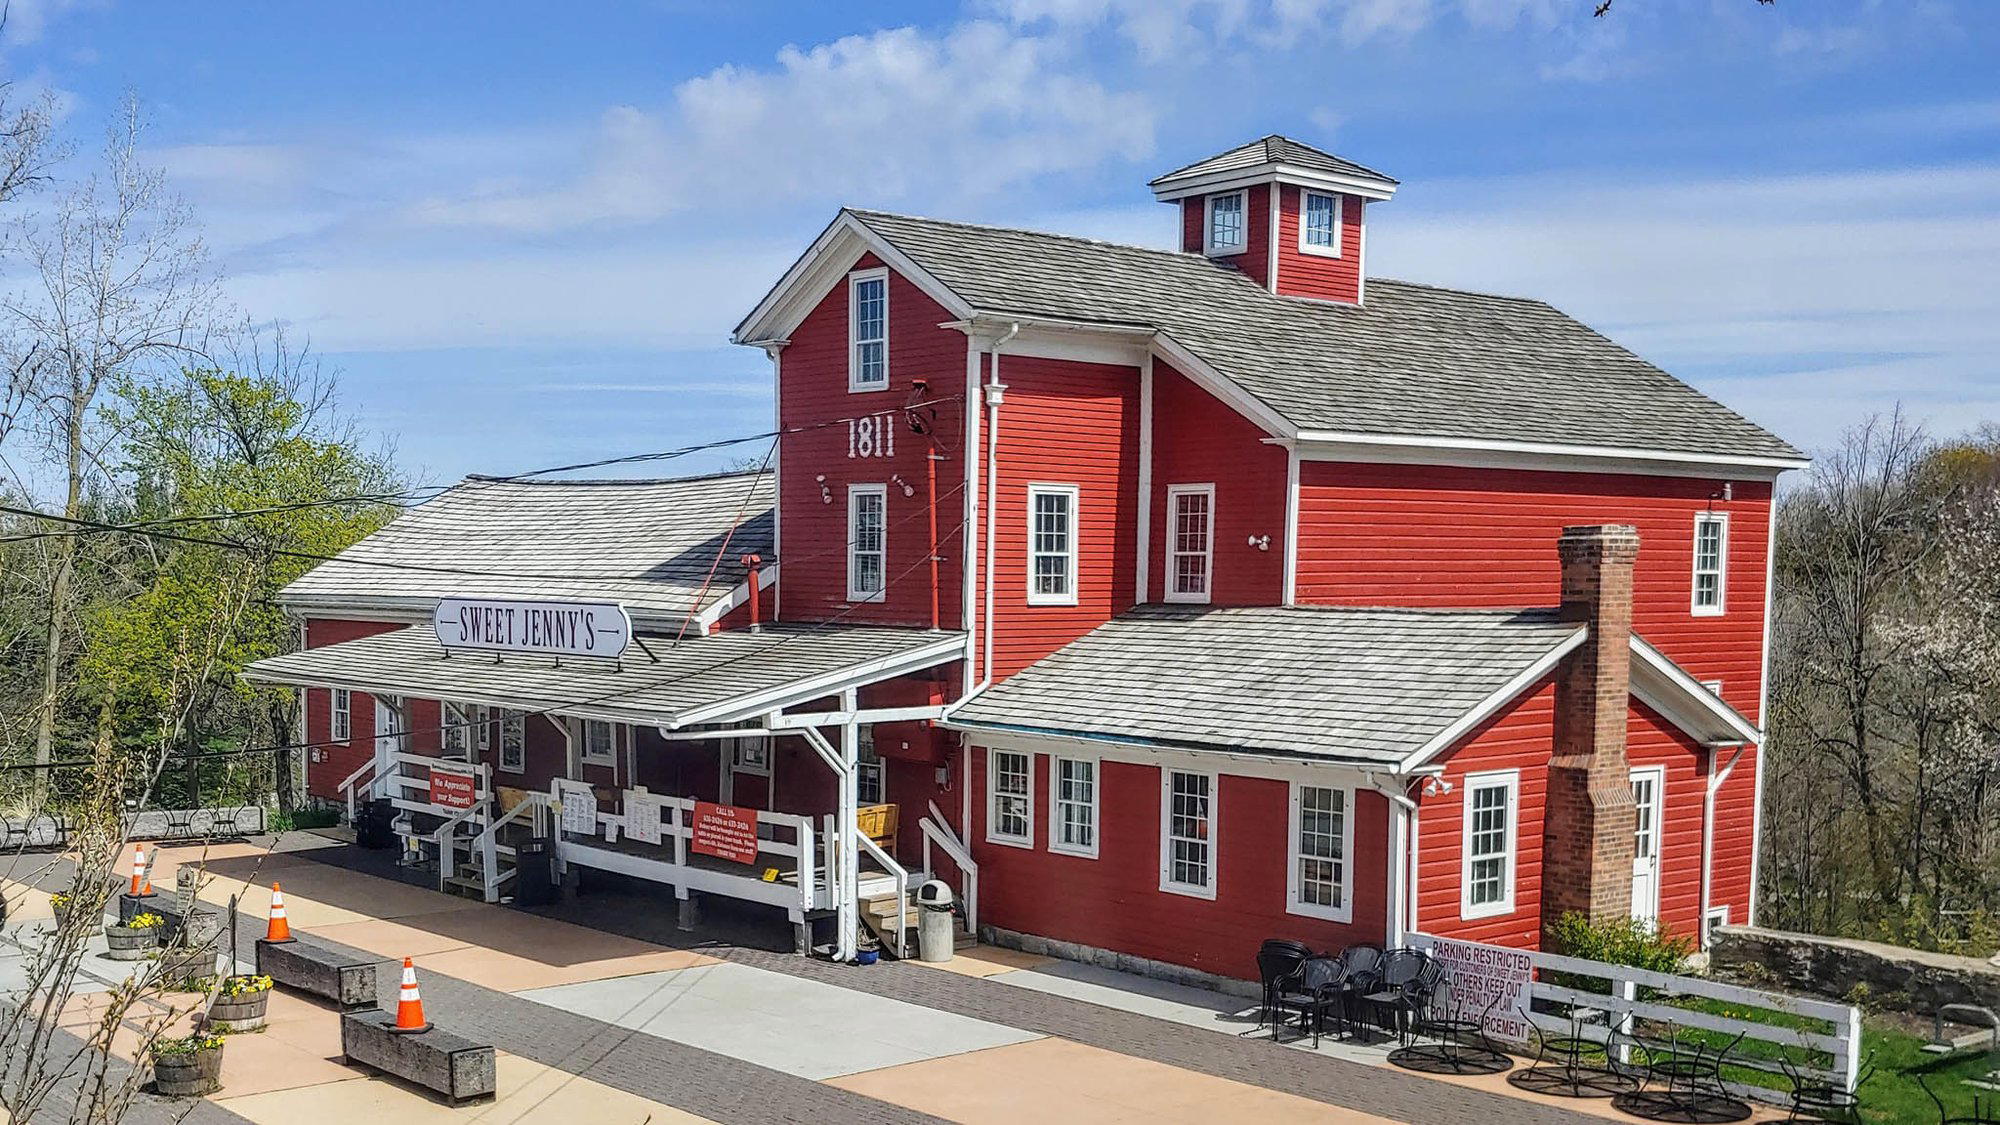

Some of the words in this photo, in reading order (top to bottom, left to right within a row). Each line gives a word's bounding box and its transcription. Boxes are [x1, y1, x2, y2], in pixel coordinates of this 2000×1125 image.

[848, 415, 894, 458] 1811
[460, 606, 514, 645] SWEET
[522, 609, 595, 650] JENNY'S
[1433, 941, 1471, 961] PARKING
[1474, 948, 1531, 971] RESTRICTED
[1460, 961, 1486, 976] CUSTOMERS
[1453, 972, 1483, 992] OTHERS
[1485, 977, 1505, 995] KEEP
[1506, 981, 1522, 998] OUT
